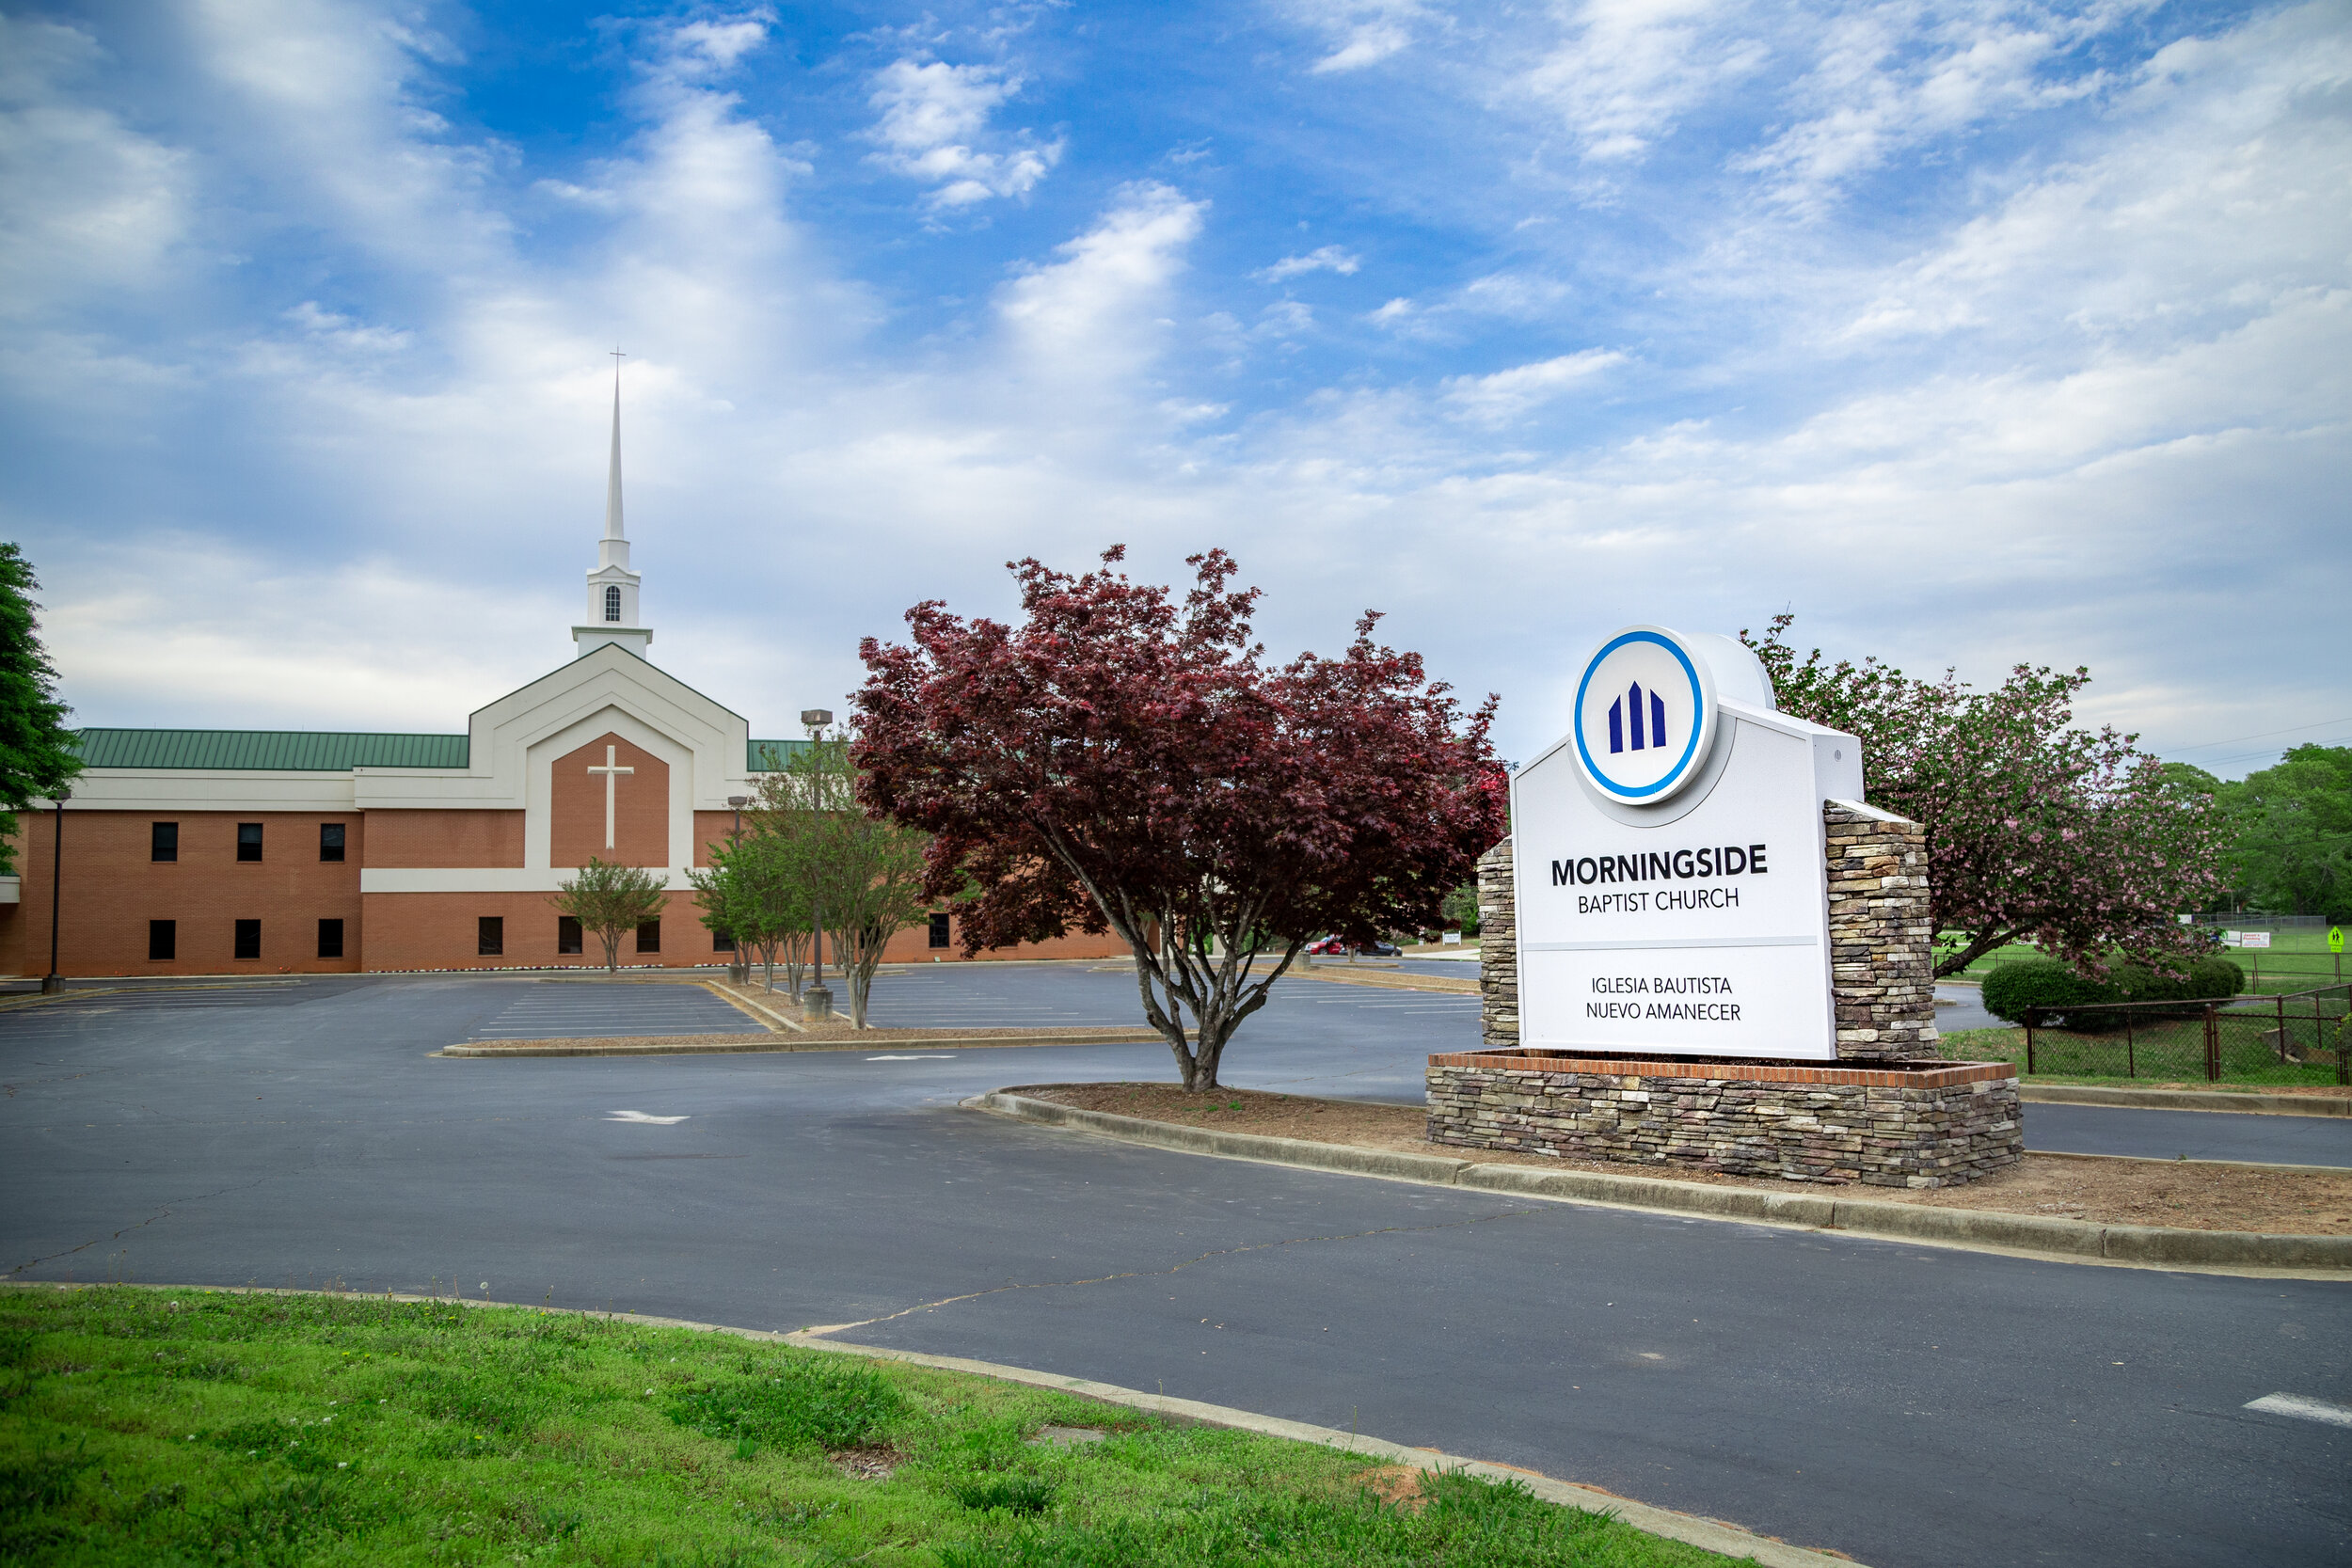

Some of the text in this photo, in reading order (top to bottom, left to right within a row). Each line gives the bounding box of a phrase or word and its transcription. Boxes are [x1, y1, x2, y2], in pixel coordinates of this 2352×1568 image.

[1551, 844, 1768, 887] MORNINGSIDE
[1578, 887, 1740, 914] BAPTIST CHURCH
[1592, 976, 1733, 994] IGLESIA BAUTISTA
[1586, 1003, 1740, 1021] NUEVO AMANECER
